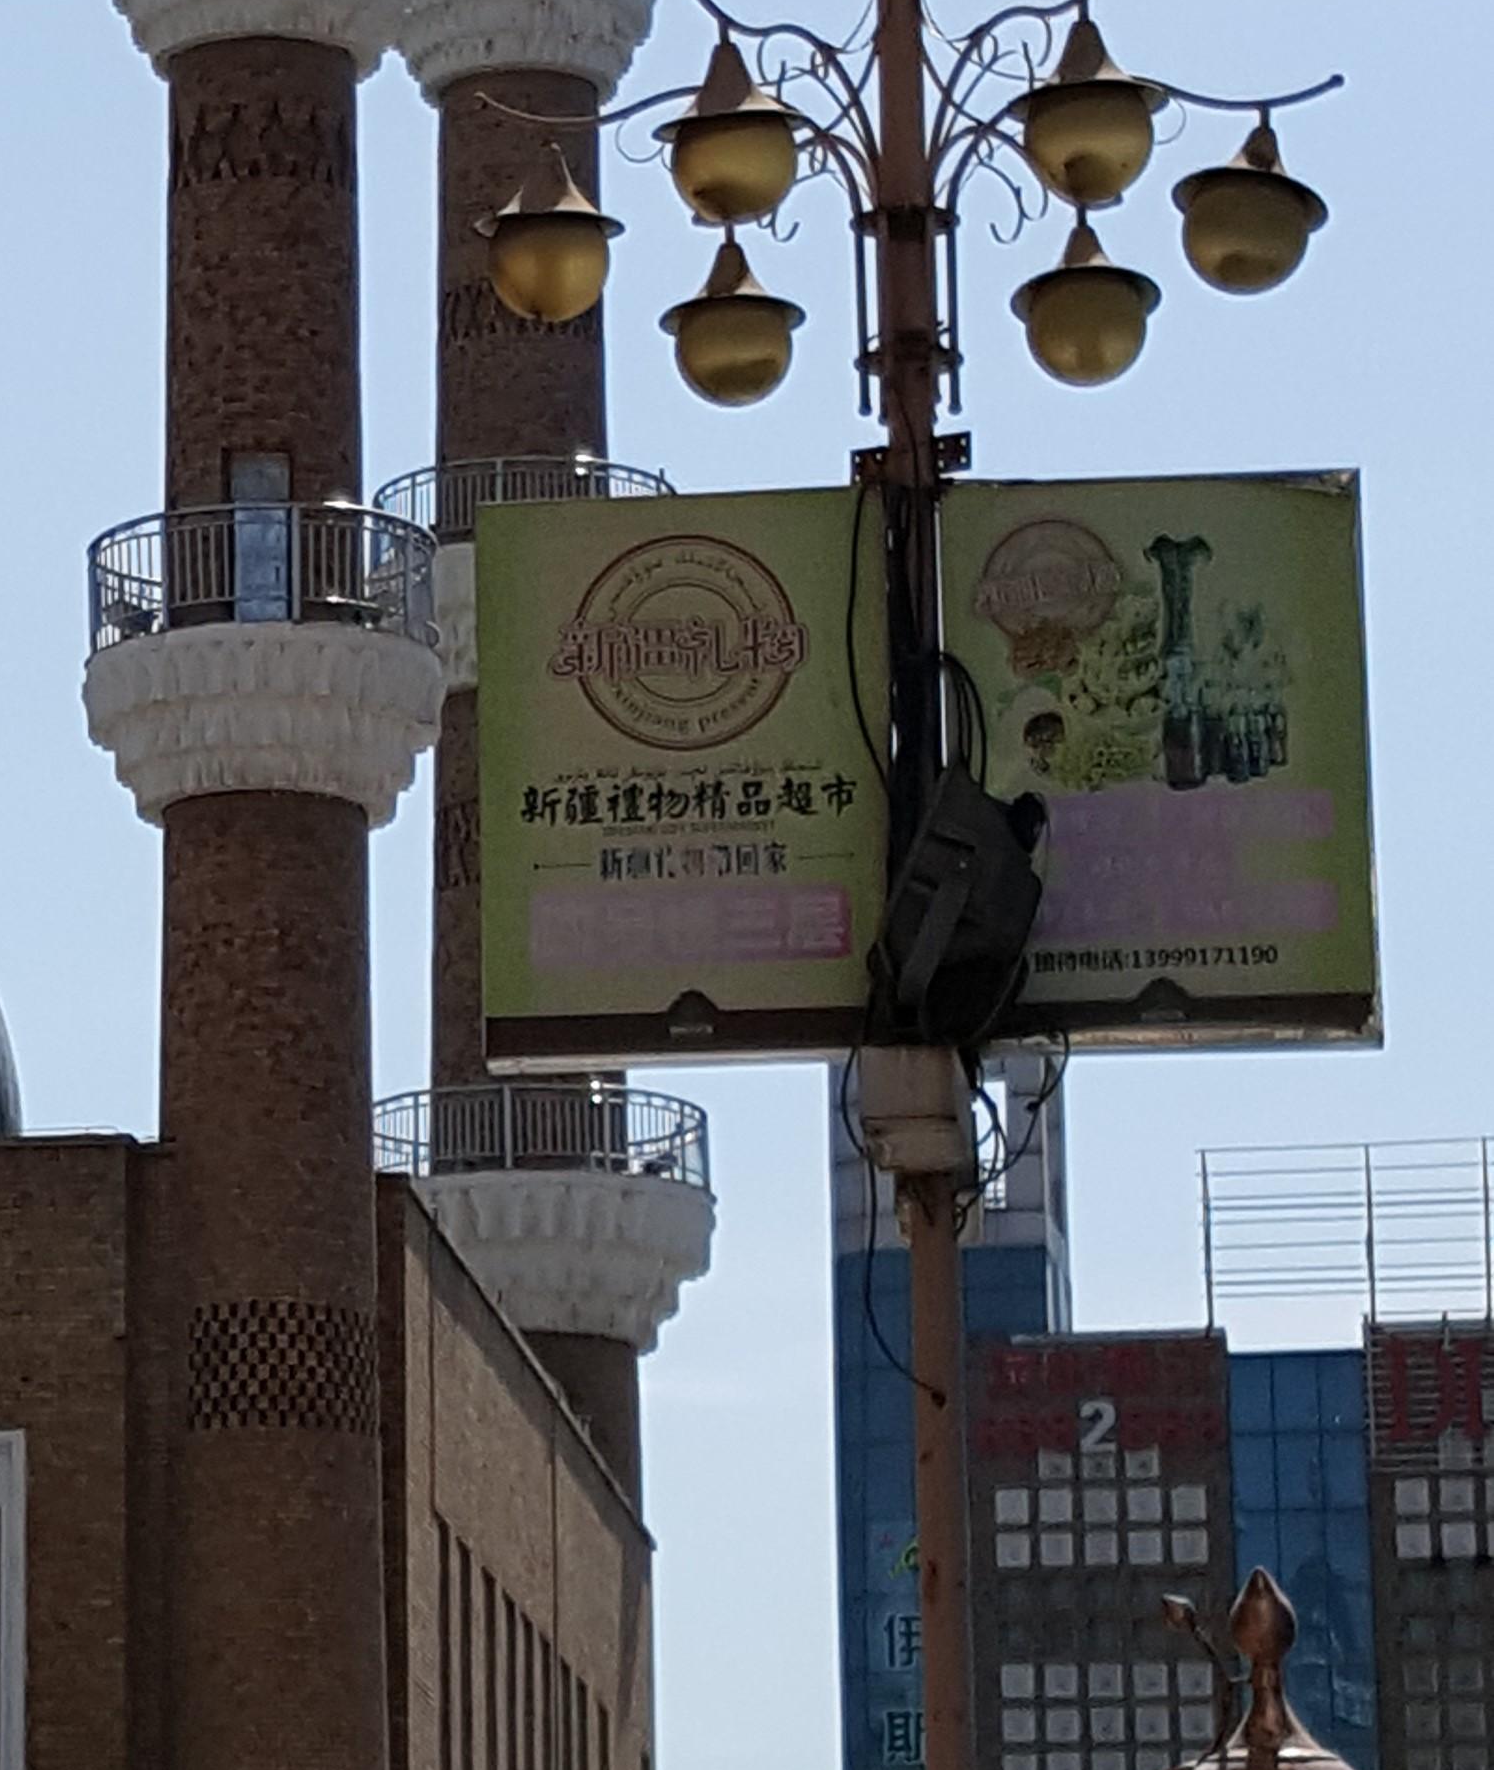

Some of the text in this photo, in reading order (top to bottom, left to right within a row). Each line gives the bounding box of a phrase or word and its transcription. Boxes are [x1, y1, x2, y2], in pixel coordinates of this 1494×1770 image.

[520, 772, 858, 826] 新疆禮物精品超市
[1079, 1402, 1118, 1453] 2
